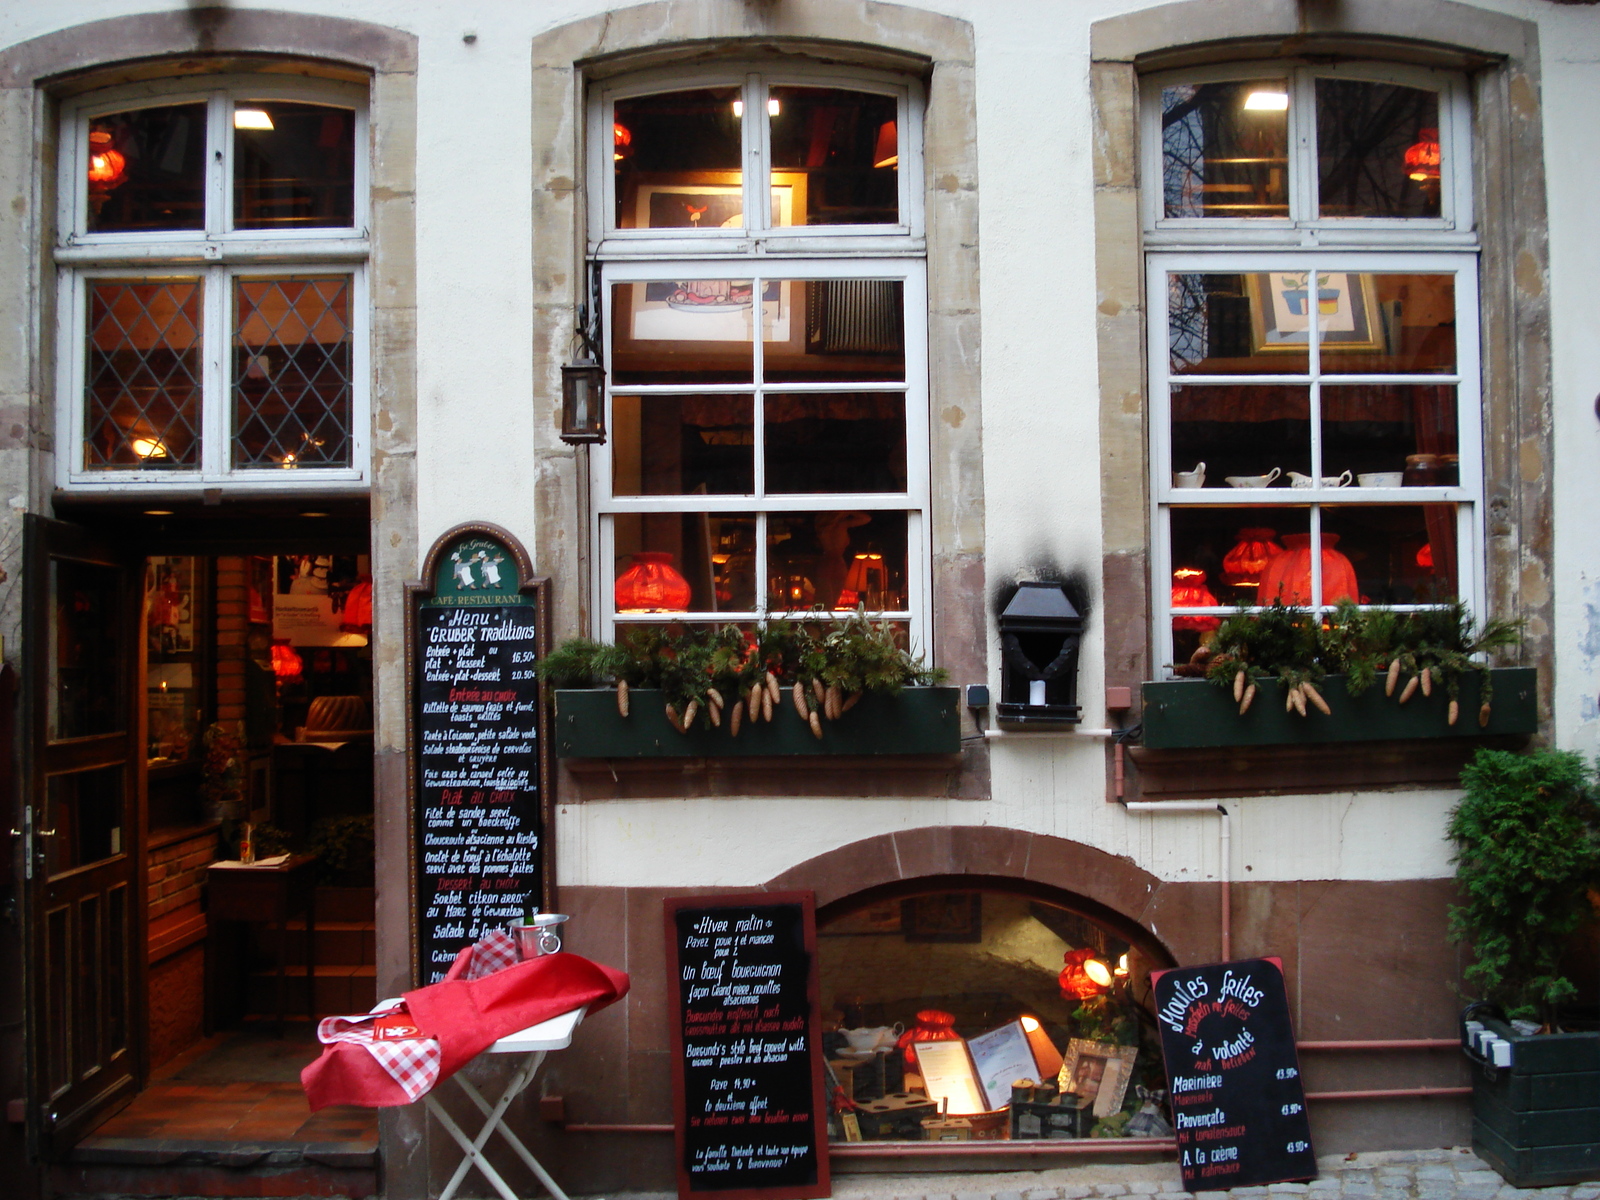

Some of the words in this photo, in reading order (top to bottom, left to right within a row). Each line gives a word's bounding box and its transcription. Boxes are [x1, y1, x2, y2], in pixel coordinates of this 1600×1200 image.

[469, 539, 496, 550] Gruber
[448, 609, 490, 626] Menu
[457, 643, 475, 660] plat
[489, 647, 499, 655] ou
[424, 657, 441, 673] plat
[456, 655, 486, 668] dessert
[481, 691, 492, 702] au
[450, 701, 459, 713] de
[461, 703, 485, 713] saumon
[485, 702, 503, 713] frais
[506, 700, 514, 711] et
[443, 730, 448, 740] à
[498, 726, 520, 739] salade
[422, 742, 444, 754] Salade
[492, 742, 500, 754] de
[458, 754, 465, 763] et
[424, 768, 438, 779] Foie
[459, 767, 467, 778] de
[518, 769, 529, 778] au
[470, 790, 485, 804] au
[425, 807, 443, 819] Filet
[446, 806, 456, 819] de
[458, 806, 486, 819] sandre
[489, 806, 511, 818] servi
[428, 819, 454, 828] comme
[462, 819, 473, 827] un
[465, 834, 505, 845] alsacienne
[506, 835, 515, 844] au
[451, 849, 460, 863] de
[485, 850, 491, 863] à
[425, 863, 446, 874] servi
[447, 864, 465, 874] avec
[468, 862, 480, 873] des
[482, 864, 509, 878] pommes
[508, 861, 534, 878] frites
[480, 879, 491, 890] au
[433, 890, 462, 905] Sorbet
[468, 889, 498, 904] citron
[426, 907, 440, 918] au
[444, 905, 467, 918] Marc
[472, 904, 482, 917] de
[433, 921, 465, 939] Salade
[468, 923, 479, 938] de
[698, 916, 729, 934] Hiver
[735, 913, 764, 932] malin
[685, 935, 709, 948] Payez
[714, 937, 732, 950] pour
[734, 936, 739, 946] 1
[740, 934, 747, 945] et
[431, 949, 459, 962] Crèm
[714, 948, 730, 959] pour
[683, 965, 696, 981] Un
[688, 984, 709, 1004] façon
[753, 980, 781, 995] nouilles
[1158, 976, 1210, 1033] Moules
[1217, 970, 1265, 1008] frites
[1212, 1026, 1255, 1060] volonté
[710, 1078, 729, 1091] Paye
[1172, 1073, 1223, 1094] Marinière
[1177, 1107, 1226, 1130] Provençale
[757, 1145, 764, 1156] et
[1182, 1150, 1192, 1167] A
[1195, 1147, 1206, 1165] la
[1210, 1145, 1238, 1163] crème
